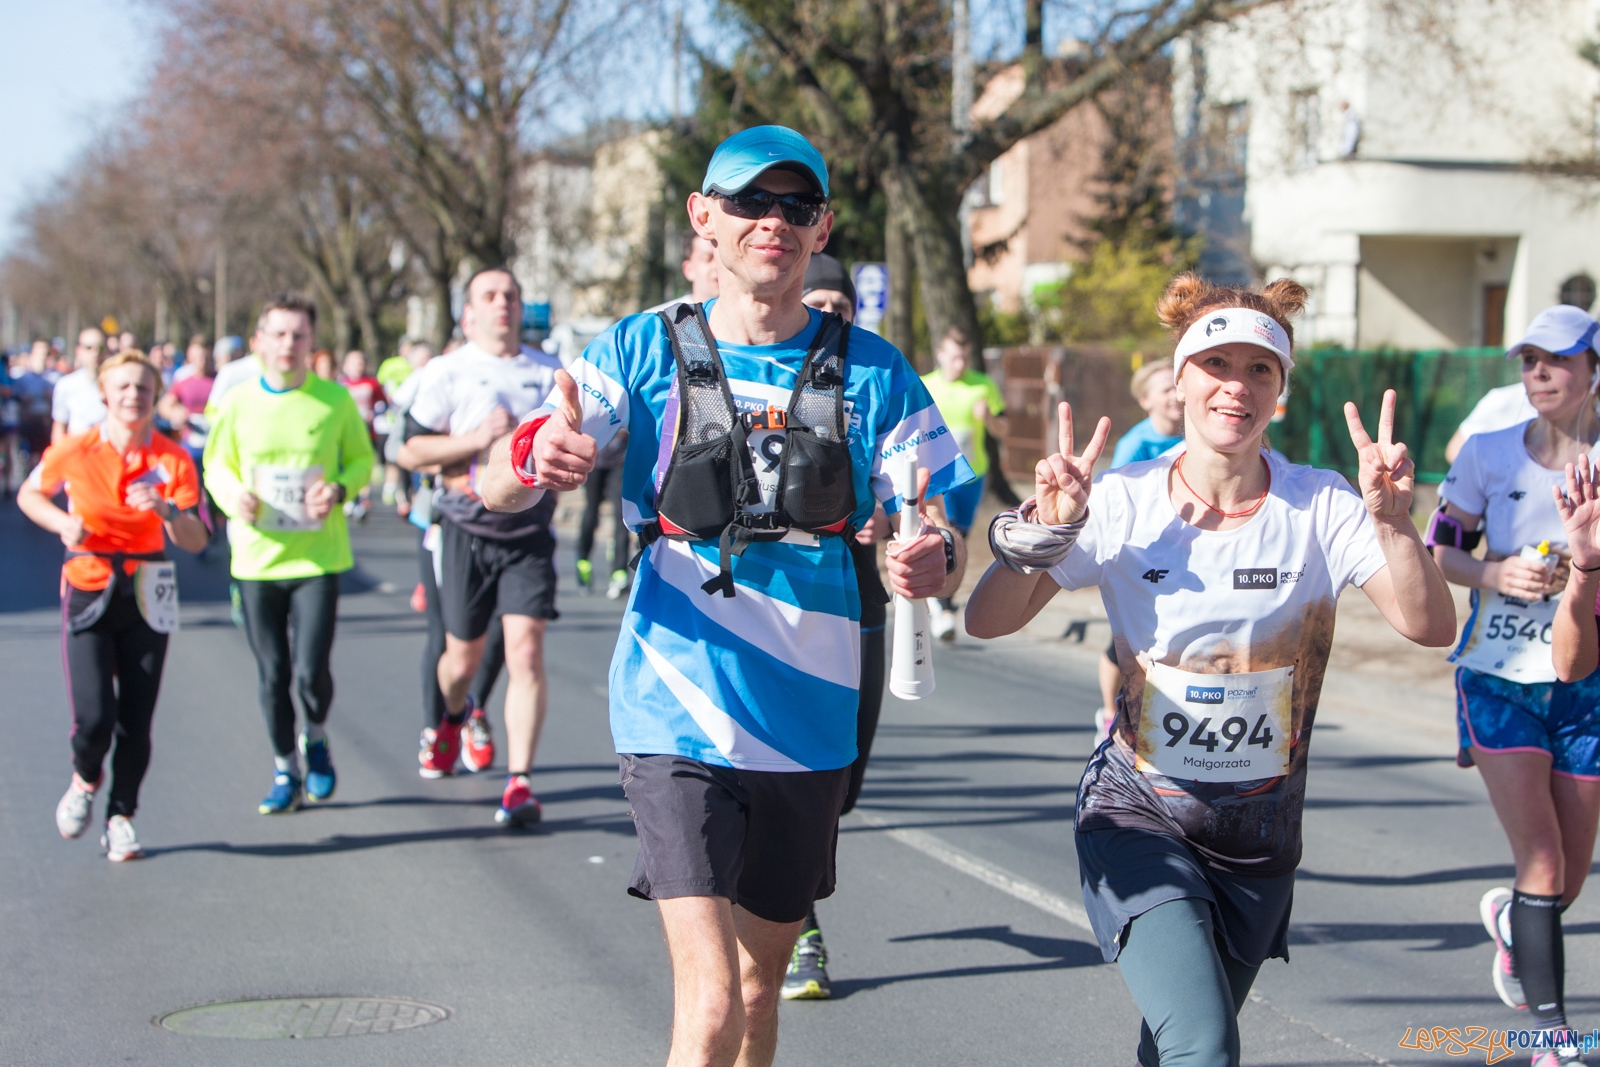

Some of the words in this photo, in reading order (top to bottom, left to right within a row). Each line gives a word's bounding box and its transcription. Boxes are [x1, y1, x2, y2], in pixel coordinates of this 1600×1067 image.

[1254, 325, 1276, 340] TOYOTA
[744, 401, 765, 412] PKO
[1142, 568, 1170, 583] 4F
[1237, 574, 1251, 584] 10.
[1252, 573, 1274, 584] PKO
[1189, 690, 1202, 699] 10.
[1203, 692, 1222, 700] PKO
[1162, 712, 1274, 753] 9494
[1183, 756, 1251, 770] Małgorzata
